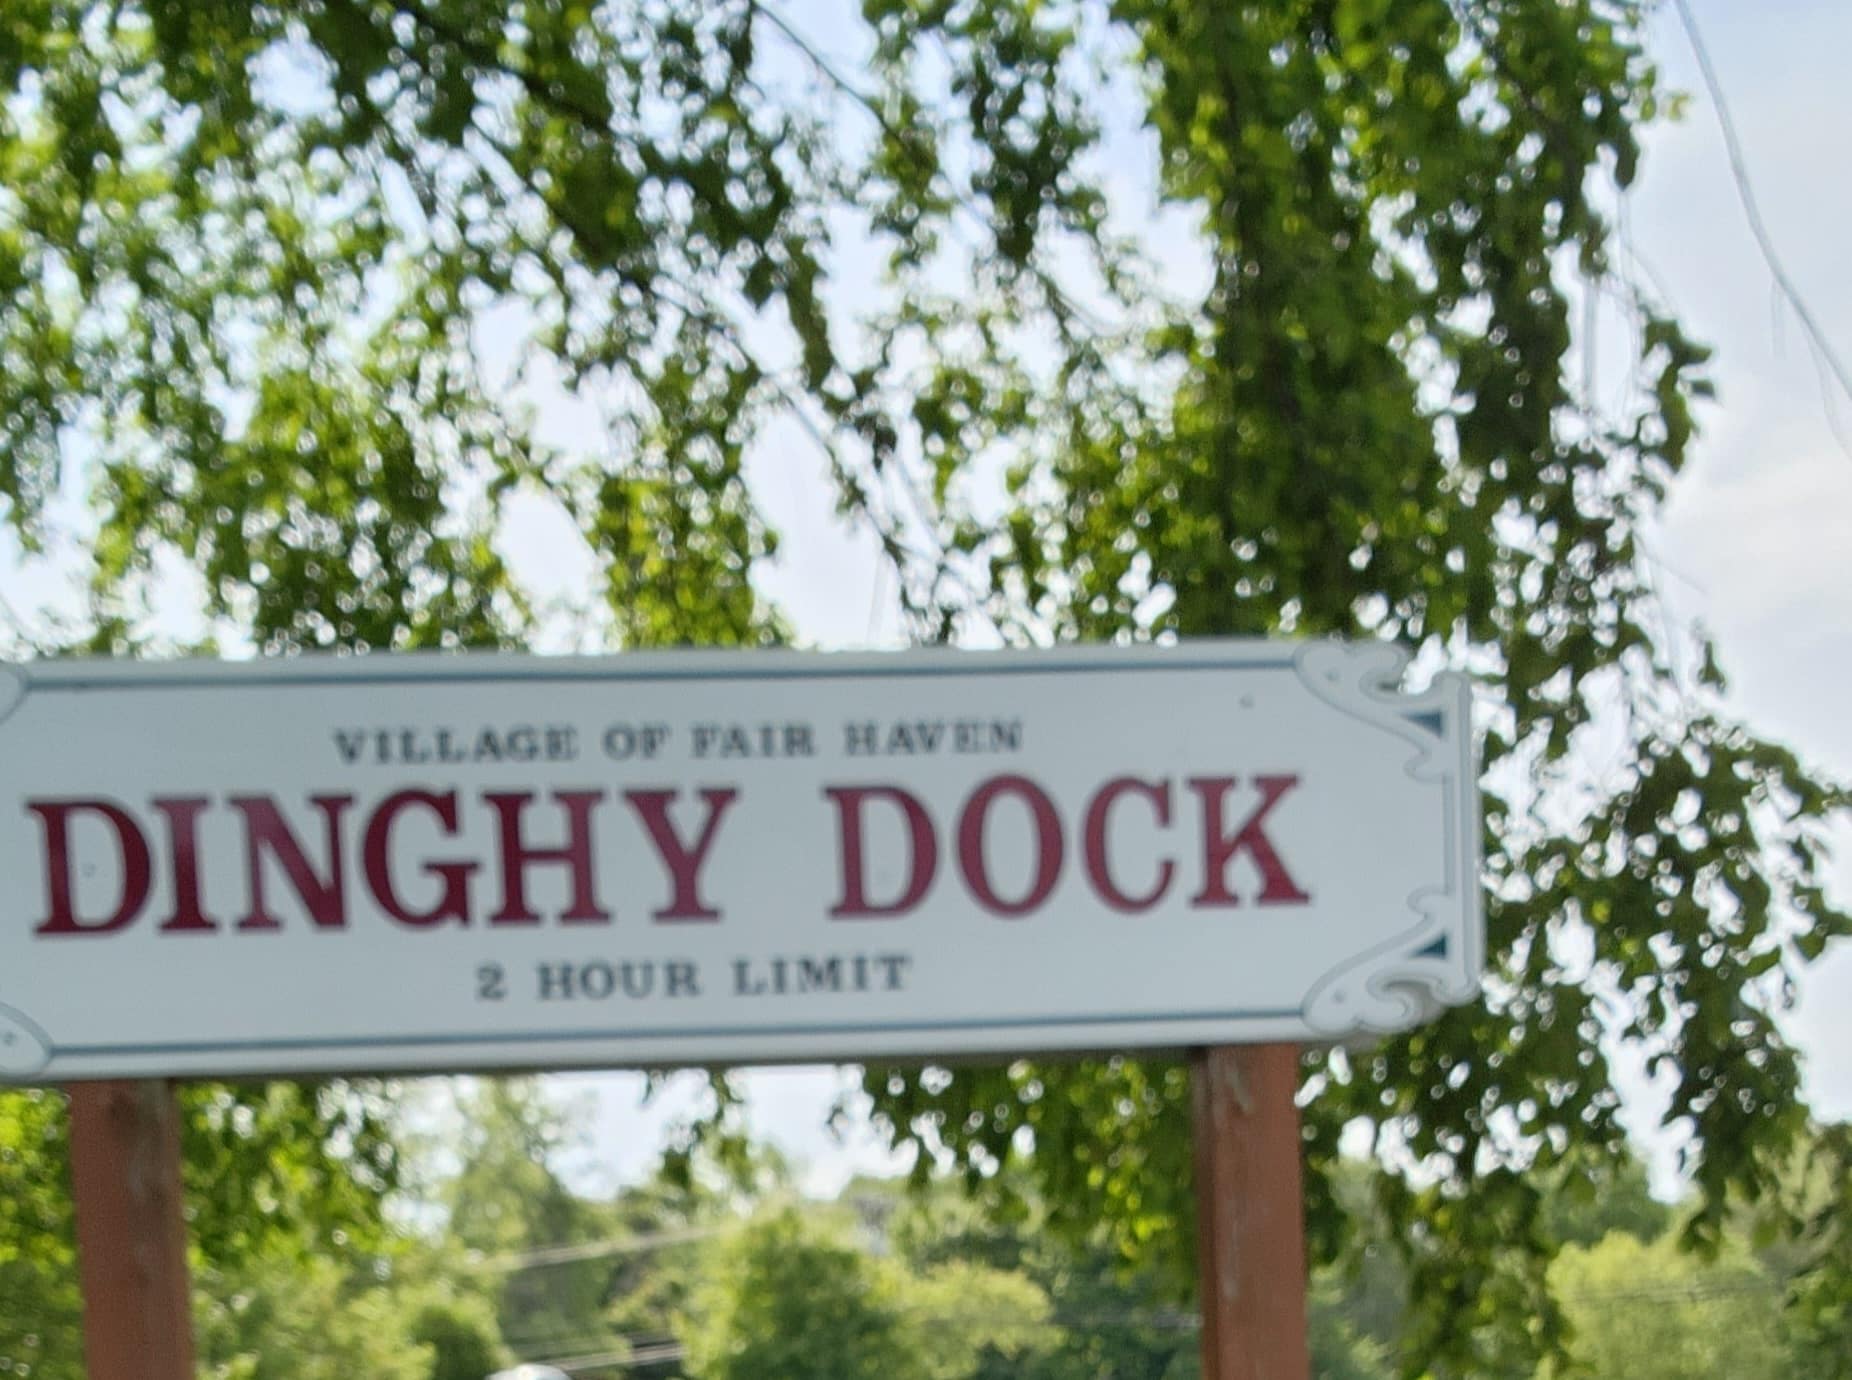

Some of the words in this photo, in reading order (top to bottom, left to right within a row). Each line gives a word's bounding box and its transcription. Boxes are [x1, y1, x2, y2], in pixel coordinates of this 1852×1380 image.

[334, 725, 578, 765] VILLAGE
[602, 723, 670, 761] OF
[692, 722, 816, 759] FAIR
[844, 718, 1022, 757] HAVEN
[26, 784, 740, 937] DINGHY
[822, 773, 1311, 919] DOCK
[476, 963, 508, 1001] 2
[536, 959, 702, 1001] HOUR
[733, 954, 914, 997] LIMIT
